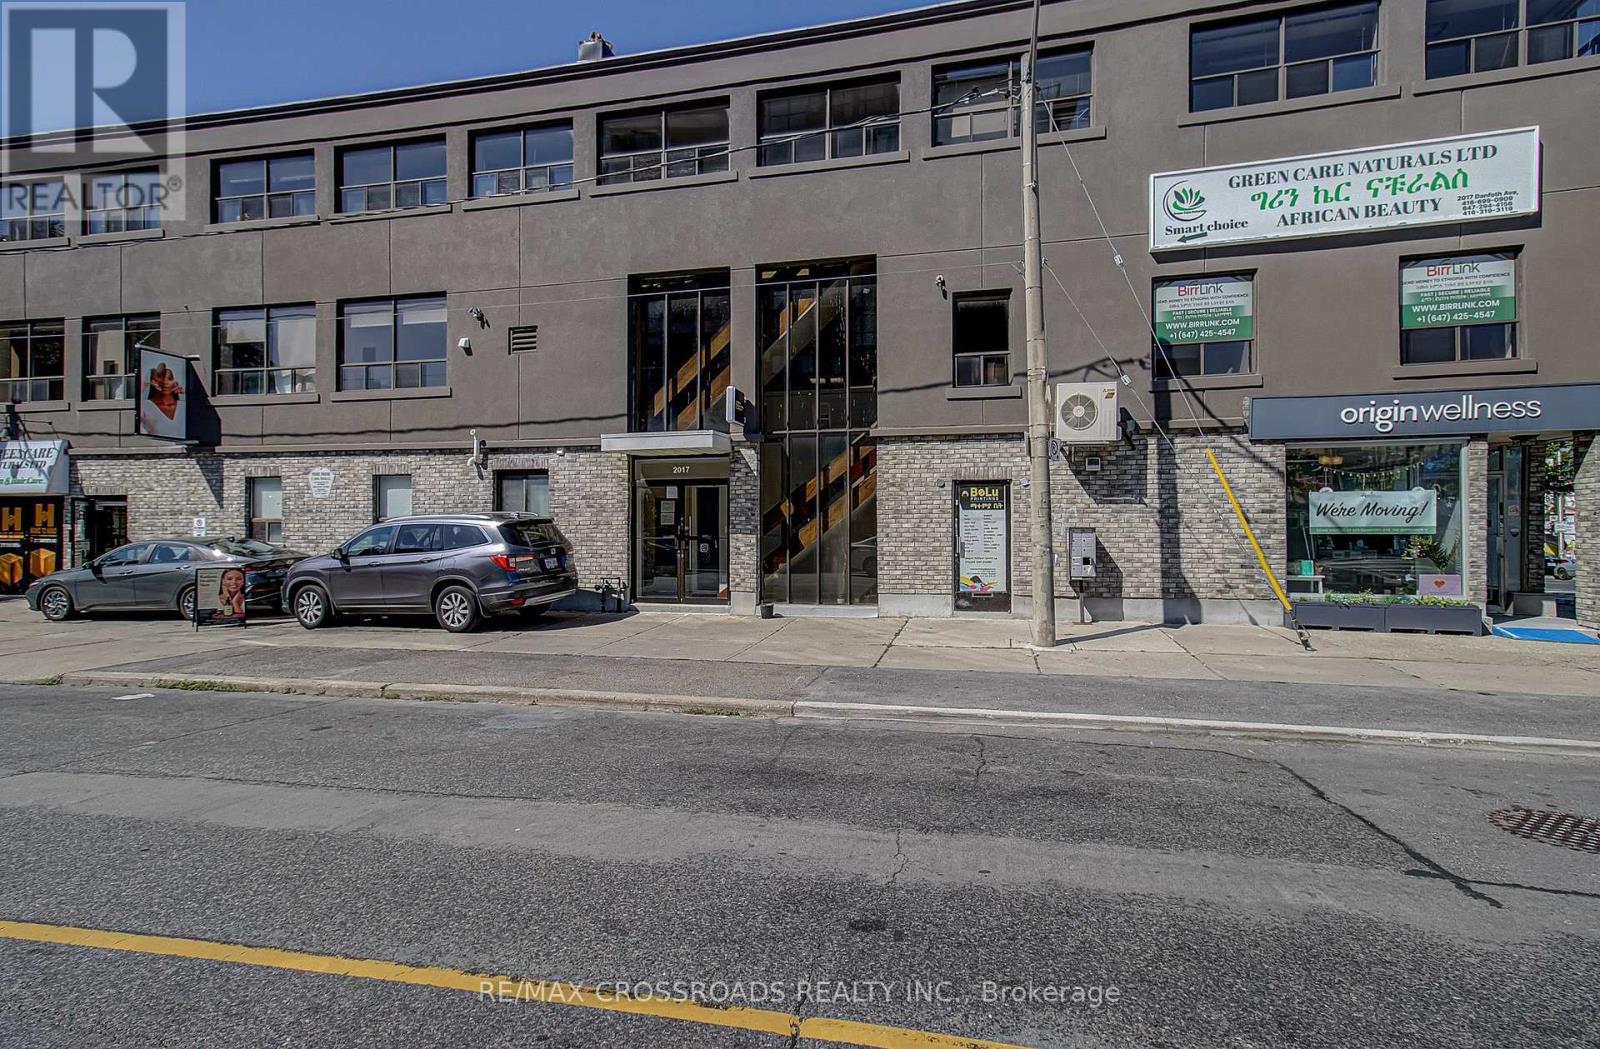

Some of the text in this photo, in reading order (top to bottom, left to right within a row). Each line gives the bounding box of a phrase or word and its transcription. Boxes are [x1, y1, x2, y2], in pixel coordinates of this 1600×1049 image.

[1228, 145, 1497, 188] GREEN CARE NATURALS LTD
[1277, 198, 1442, 227] AFRICAN BEAUTY
[1165, 219, 1248, 235] Smart choice
[1426, 262, 1480, 277] BirrLink
[1178, 283, 1223, 297] BirrLink
[1427, 313, 1451, 323] (647)
[1453, 311, 1496, 321] 425-4547
[1178, 330, 1198, 340] (647)
[1200, 328, 1236, 337] 425-4547
[1340, 394, 1542, 433] origin wellness
[672, 466, 690, 474] 2017
[1360, 501, 1429, 524] Moving!
